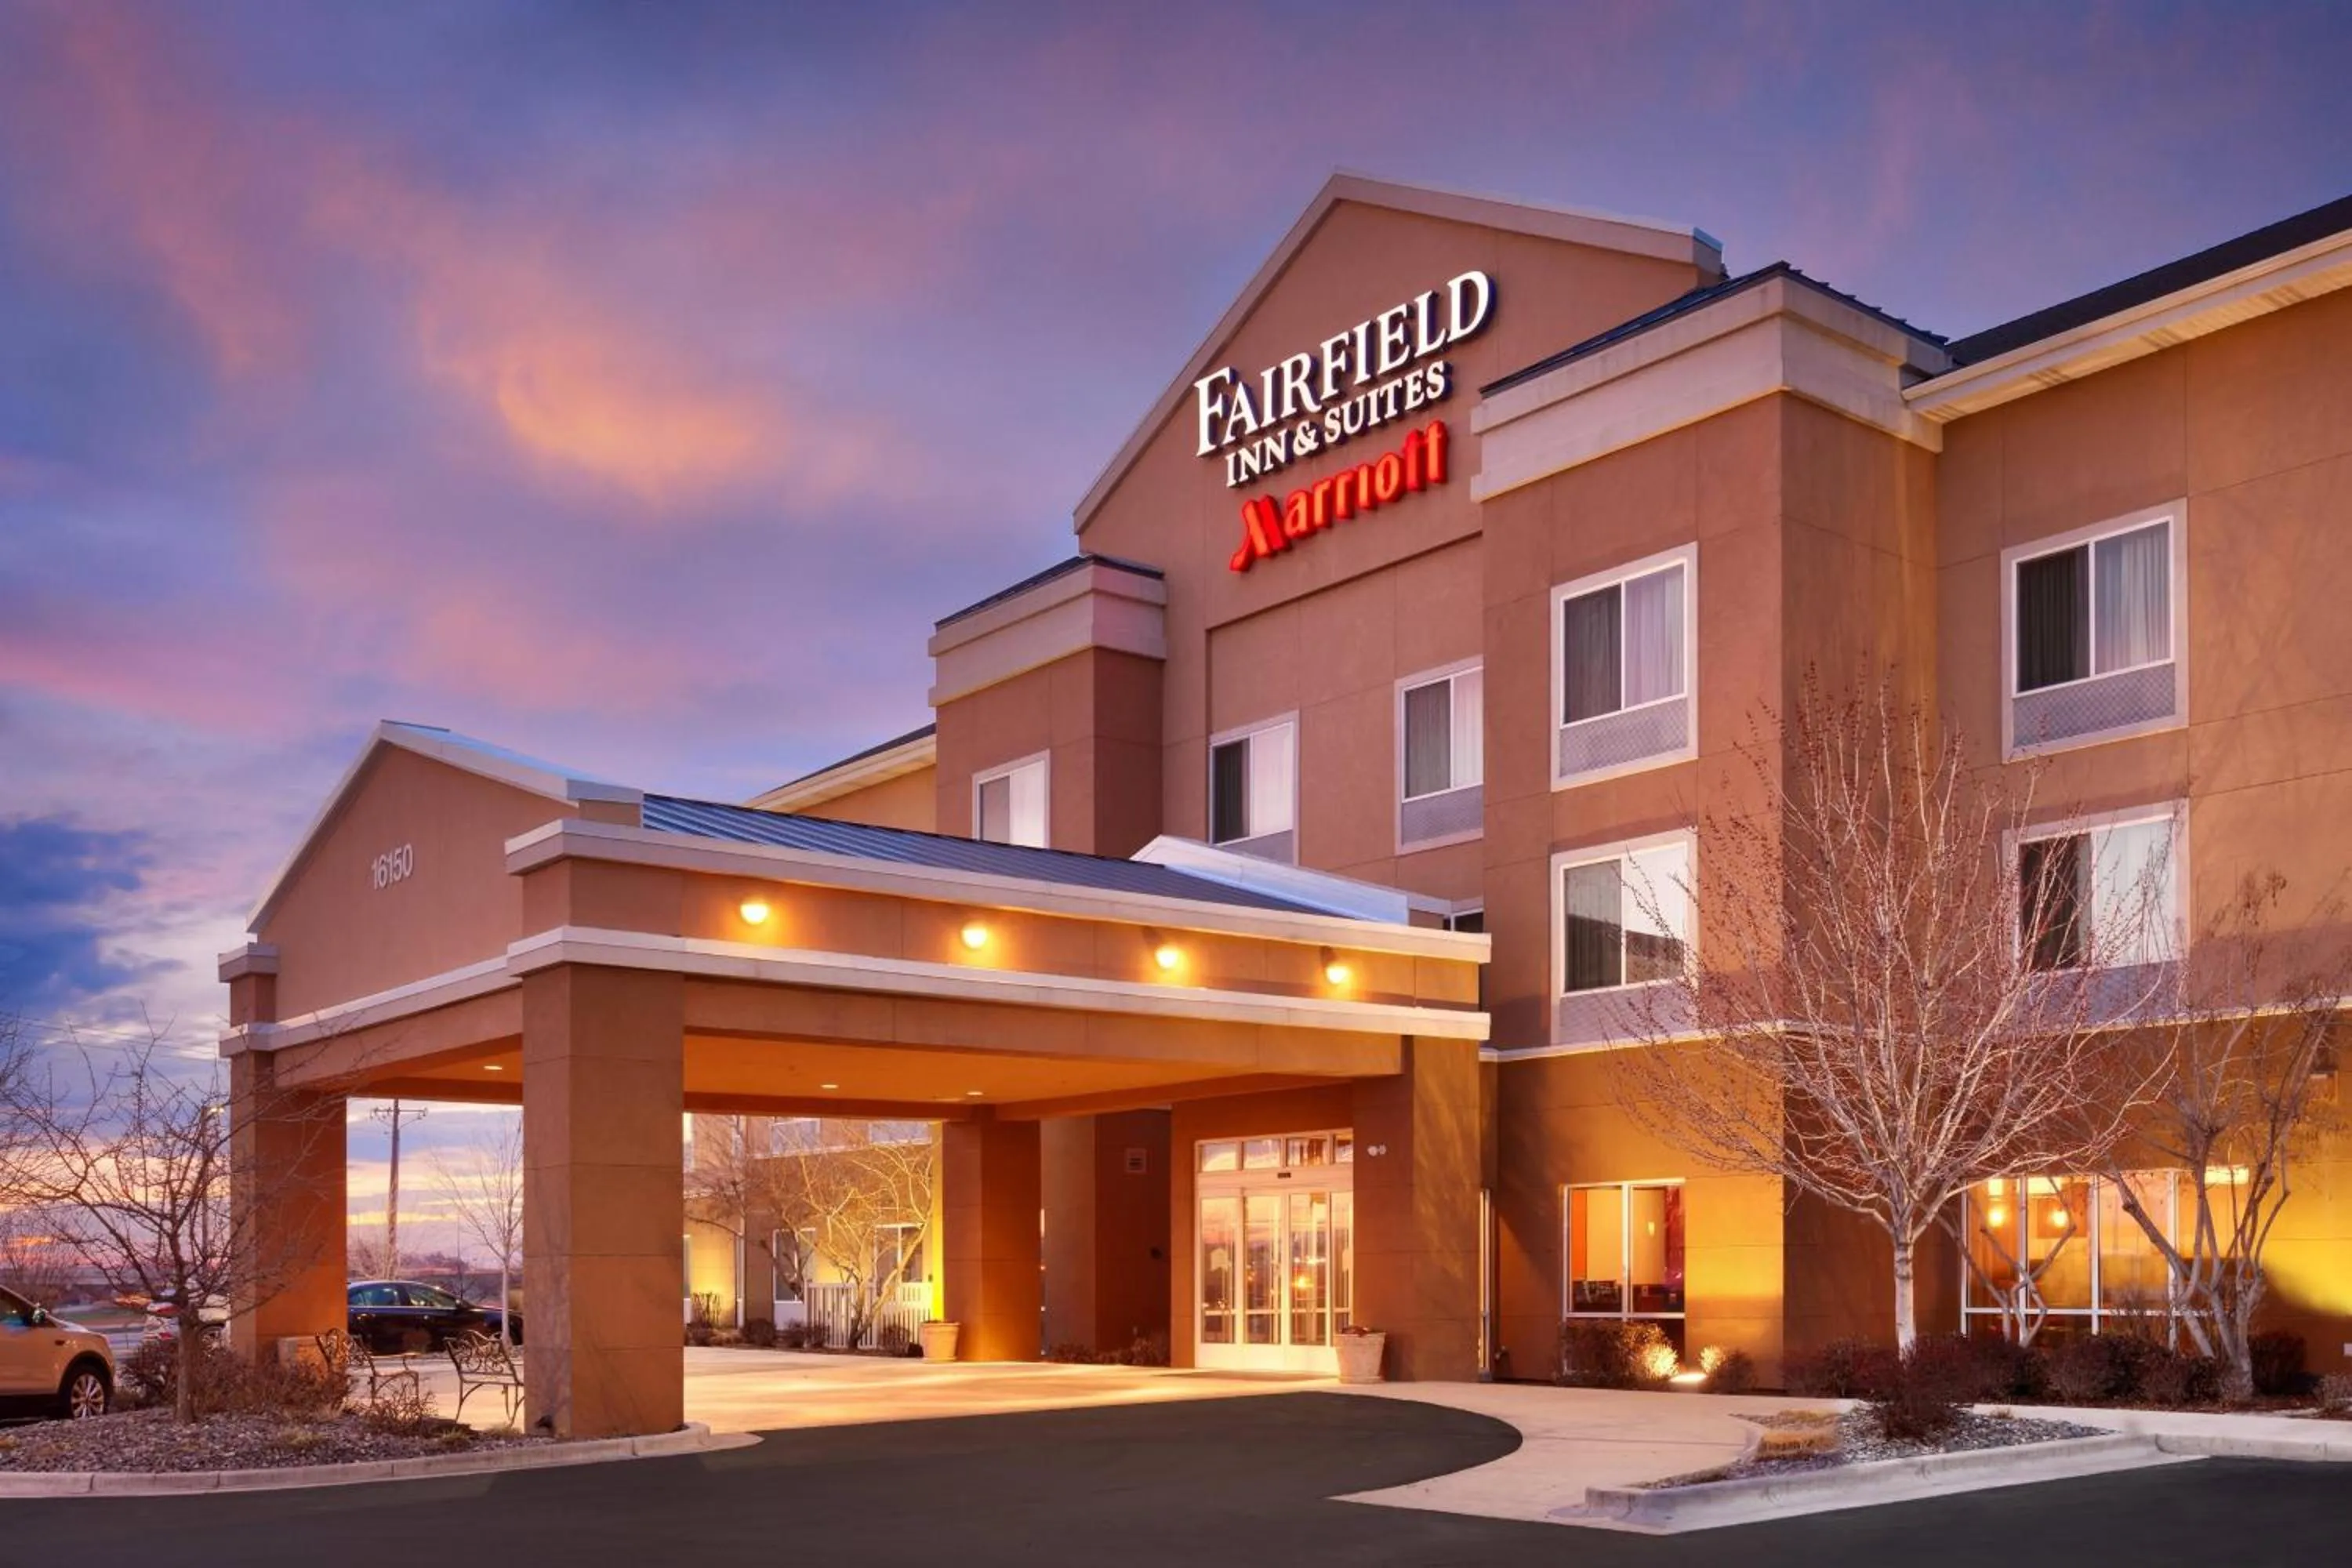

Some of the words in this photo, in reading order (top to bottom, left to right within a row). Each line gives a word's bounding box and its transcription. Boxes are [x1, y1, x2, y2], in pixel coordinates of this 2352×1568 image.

[1194, 270, 1494, 457] FAIRFIELD
[1225, 430, 1287, 488] INN
[1323, 360, 1447, 444] SUITES
[1229, 419, 1449, 572] Marriott
[371, 844, 413, 890] 16150
